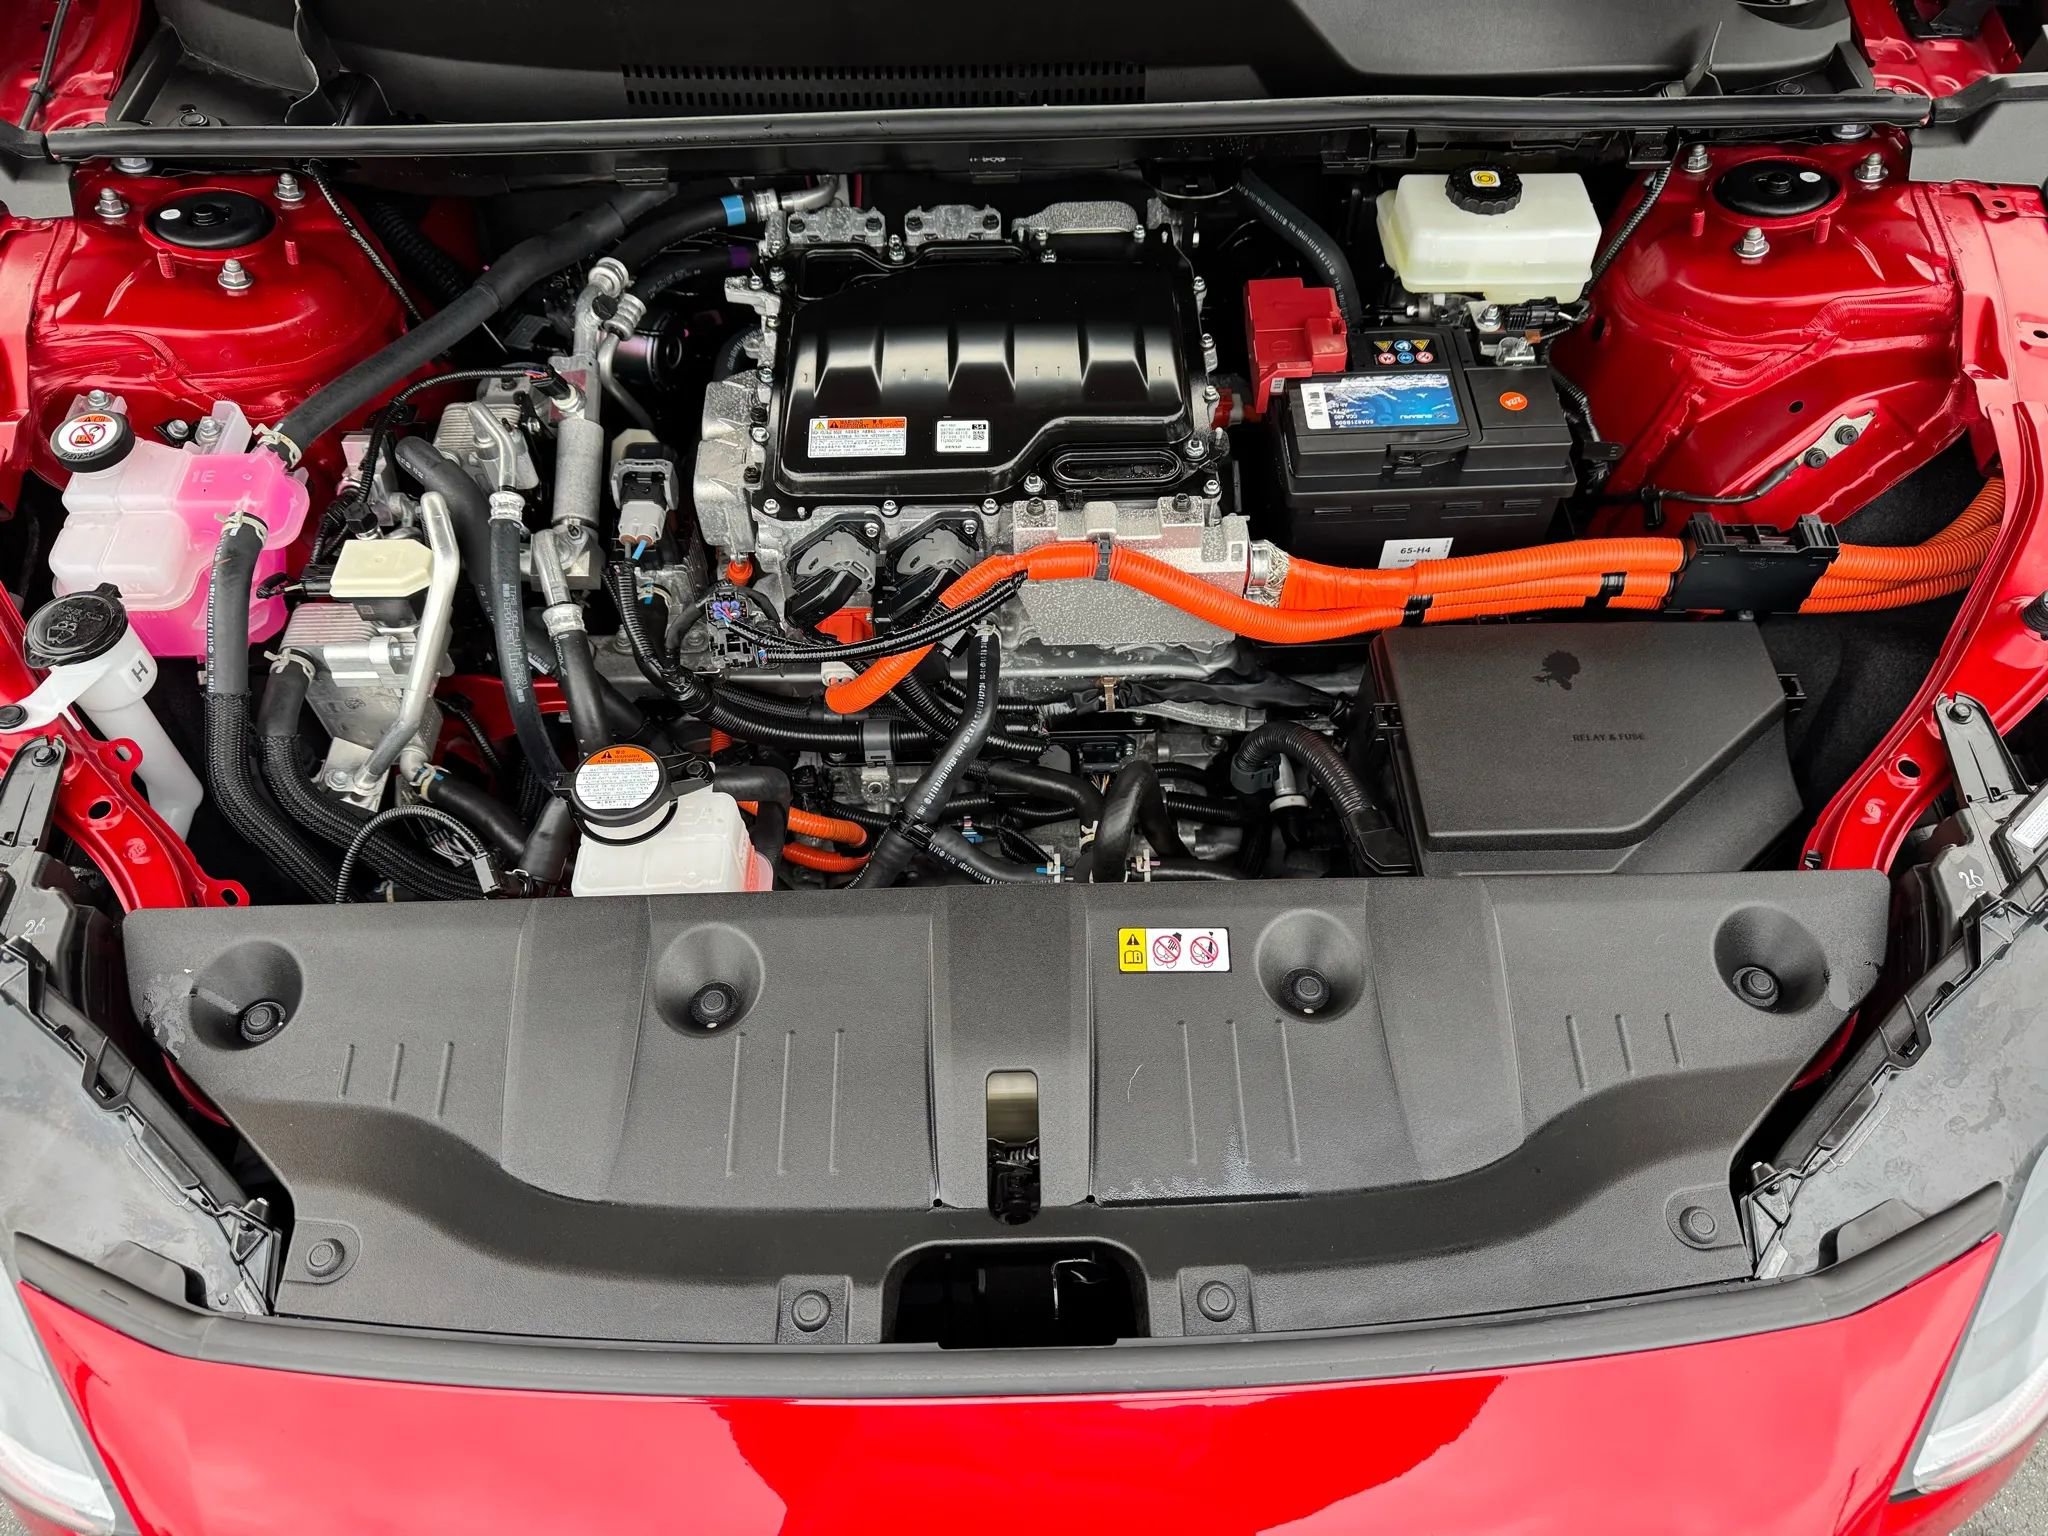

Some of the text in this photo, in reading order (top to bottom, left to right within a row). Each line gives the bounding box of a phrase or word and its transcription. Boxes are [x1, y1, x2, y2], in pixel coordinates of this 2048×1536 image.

[131, 660, 149, 683] H
[1572, 733, 1605, 742] RELAY
[1619, 732, 1645, 741] FUSE
[1958, 868, 1984, 890] 26
